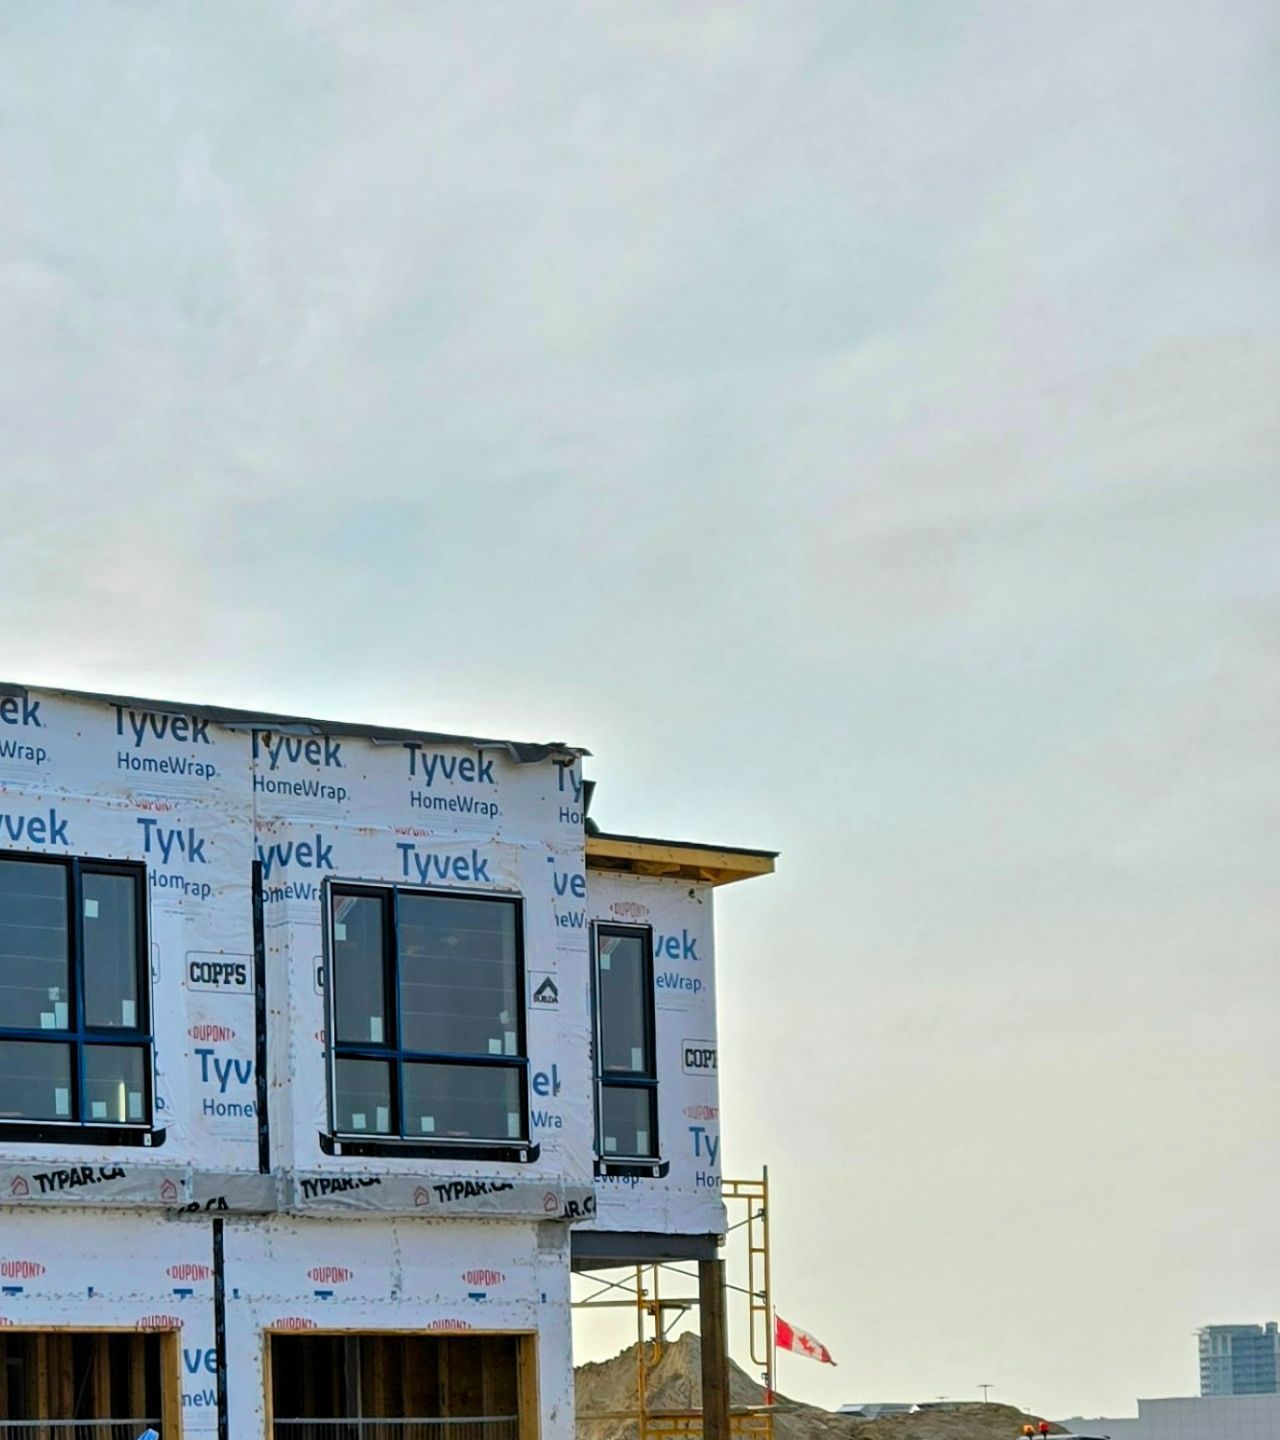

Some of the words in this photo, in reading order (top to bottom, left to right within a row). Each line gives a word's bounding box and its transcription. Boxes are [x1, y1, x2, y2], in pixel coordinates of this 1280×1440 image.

[111, 703, 211, 746] Tyvek
[118, 752, 216, 780] HomeWrap
[403, 743, 494, 786] Tyvek
[411, 791, 499, 819] HomeWrap
[396, 842, 490, 884] Tyvek
[194, 1025, 230, 1041] DUPONT
[2, 1262, 40, 1278] DUPONT
[172, 1265, 211, 1281] DUPONT
[313, 1268, 349, 1282] DUPONT
[467, 1271, 501, 1285] DUPONT
